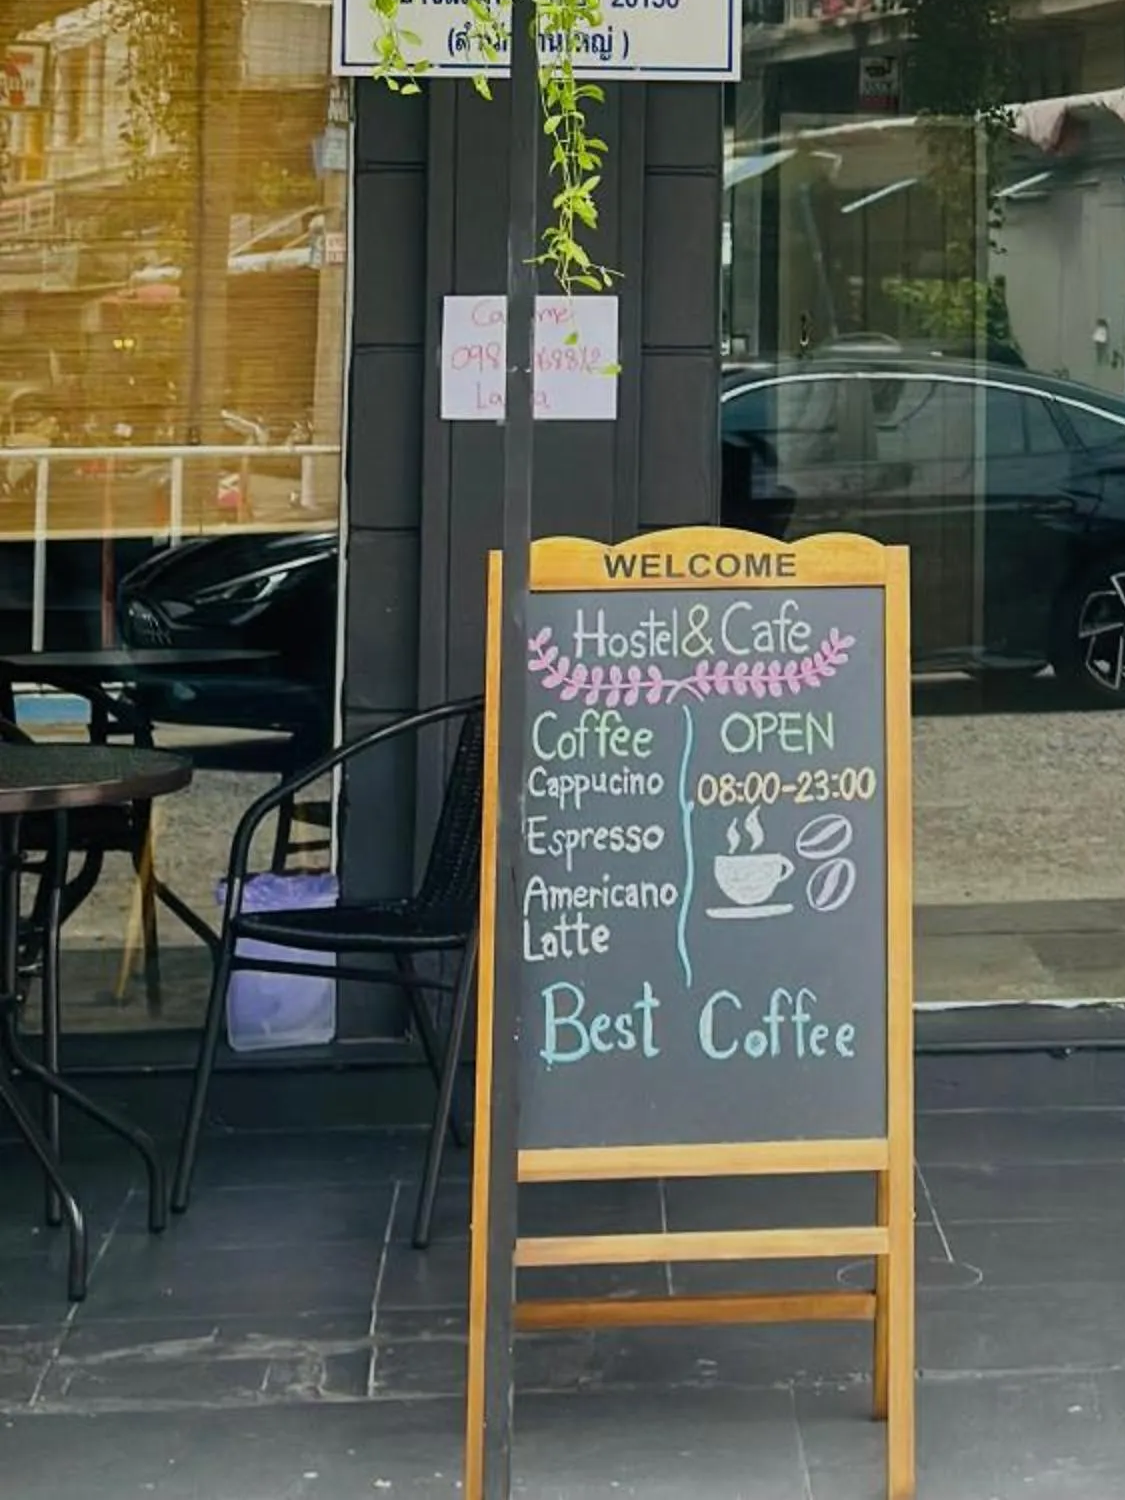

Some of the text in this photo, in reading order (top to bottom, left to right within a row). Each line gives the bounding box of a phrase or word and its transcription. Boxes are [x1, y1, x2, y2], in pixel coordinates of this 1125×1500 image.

[604, 553, 798, 579] WELCOME
[532, 709, 654, 760] Coffee
[720, 711, 835, 755] OPEN
[527, 766, 665, 809] Cappucino
[697, 766, 877, 807] 08:00-23:00
[526, 815, 666, 872] Espresso
[523, 873, 679, 916] Americano
[523, 912, 611, 963] Latte
[539, 980, 857, 1065] Best Coffee
